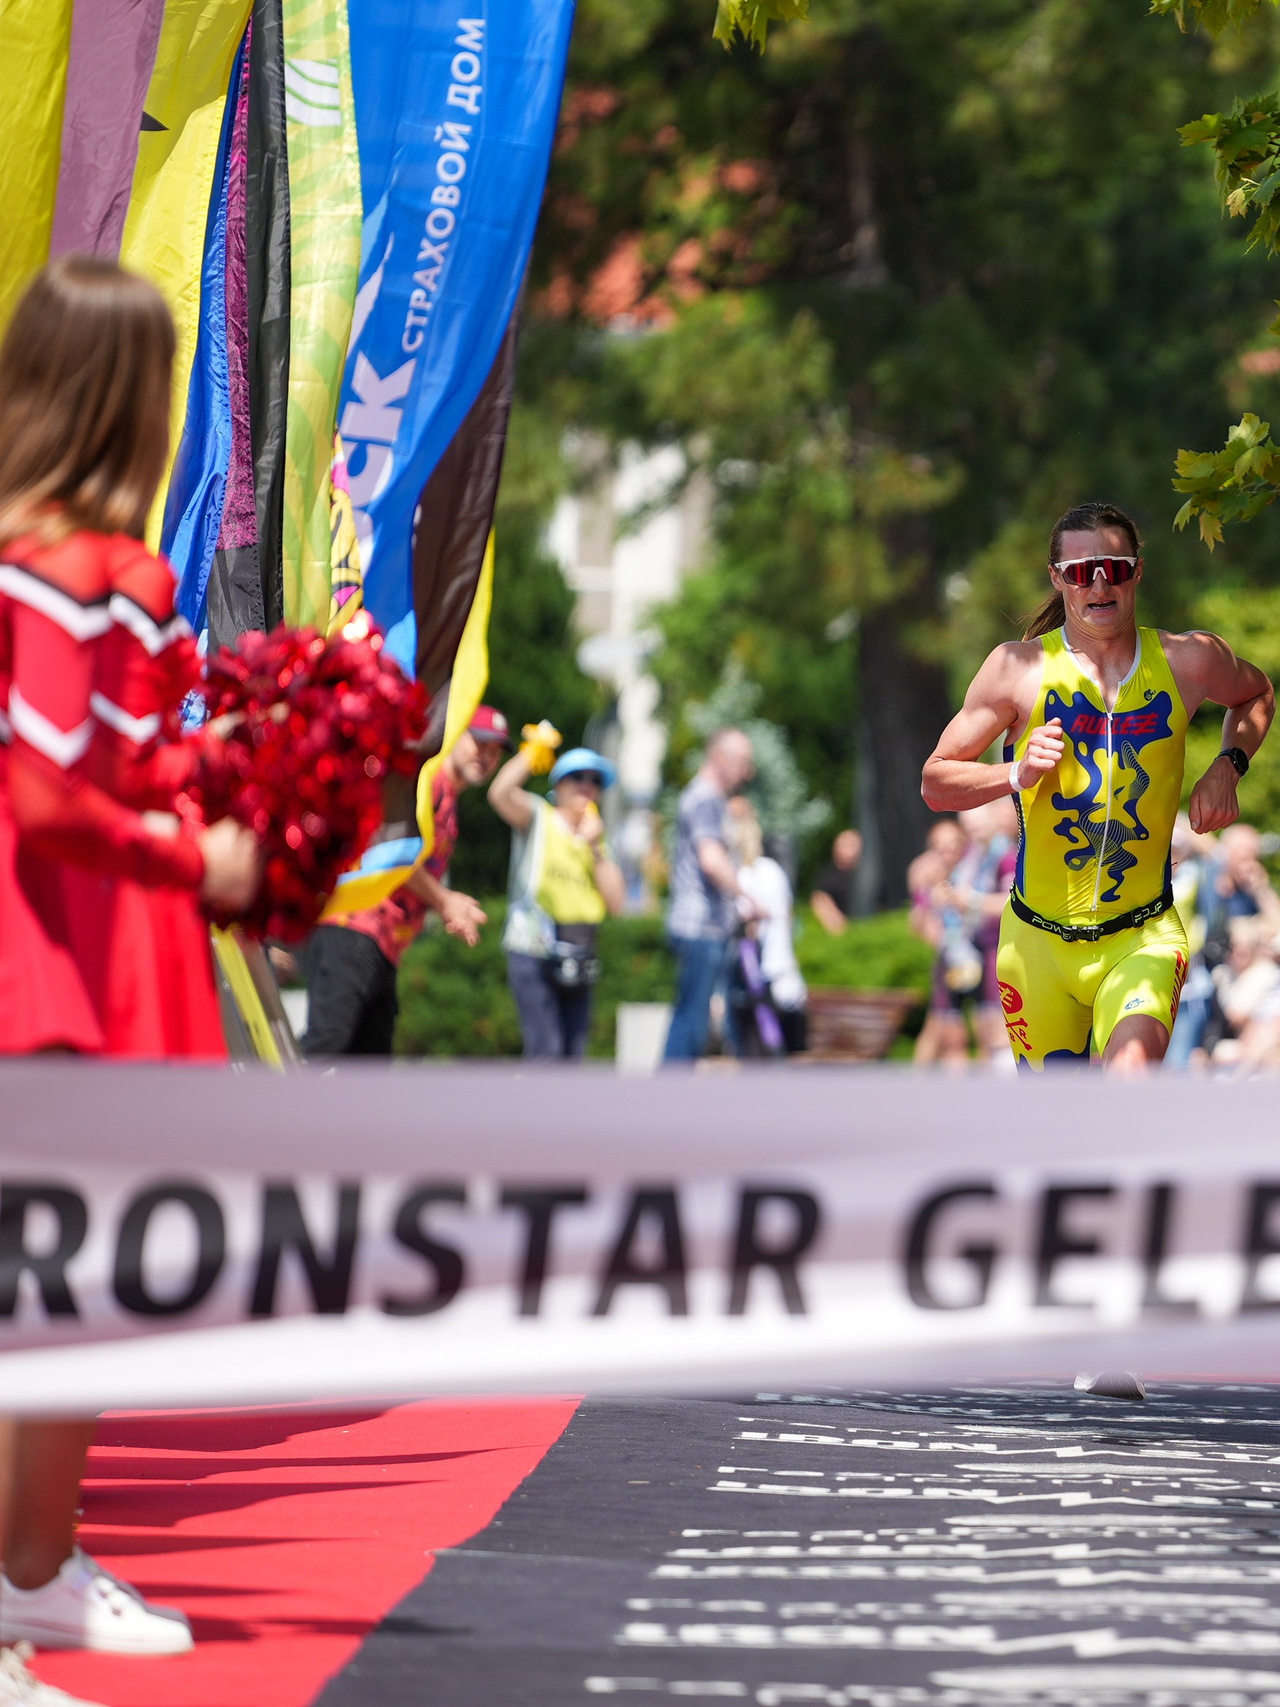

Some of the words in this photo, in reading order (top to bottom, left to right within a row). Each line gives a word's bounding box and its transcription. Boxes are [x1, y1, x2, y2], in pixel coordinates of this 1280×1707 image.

[402, 121, 473, 354] СТРАХОВОЙ
[446, 18, 486, 115] ДОМ
[1070, 712, 1158, 735] RULLEZ
